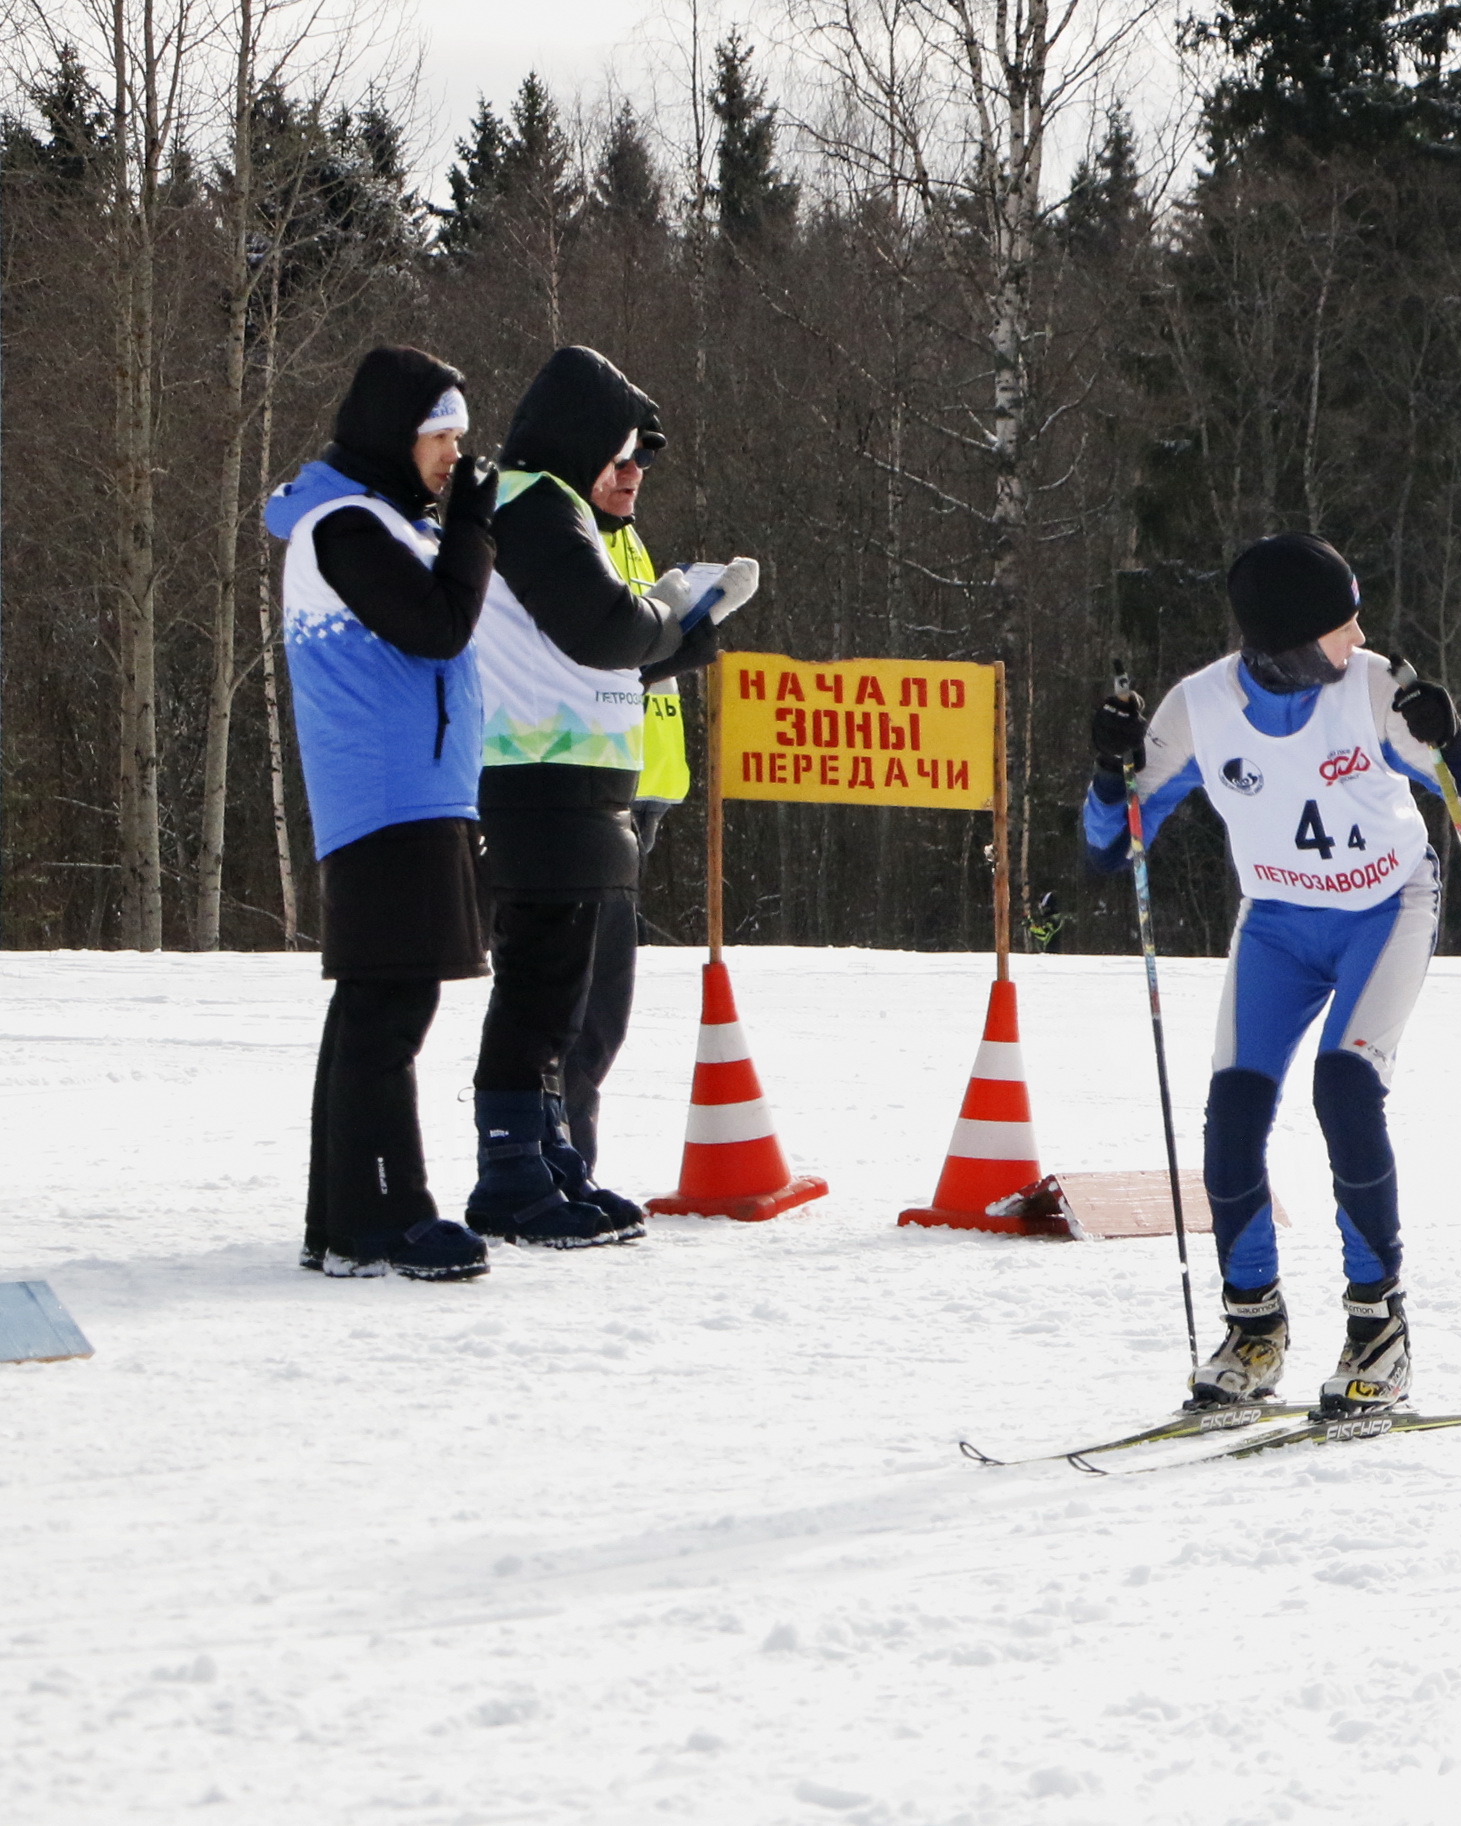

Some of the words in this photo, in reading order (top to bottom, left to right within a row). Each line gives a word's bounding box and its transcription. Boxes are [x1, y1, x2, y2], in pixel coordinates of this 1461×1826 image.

[739, 669, 966, 709] НАЧАЛО
[775, 707, 921, 751] ЗОНЫ
[742, 752, 969, 790] ПЕРЕДАЧИ
[1295, 799, 1336, 860] 4
[1348, 823, 1367, 851] 4
[1254, 848, 1400, 893] ПЕТРОЗАВОДСК
